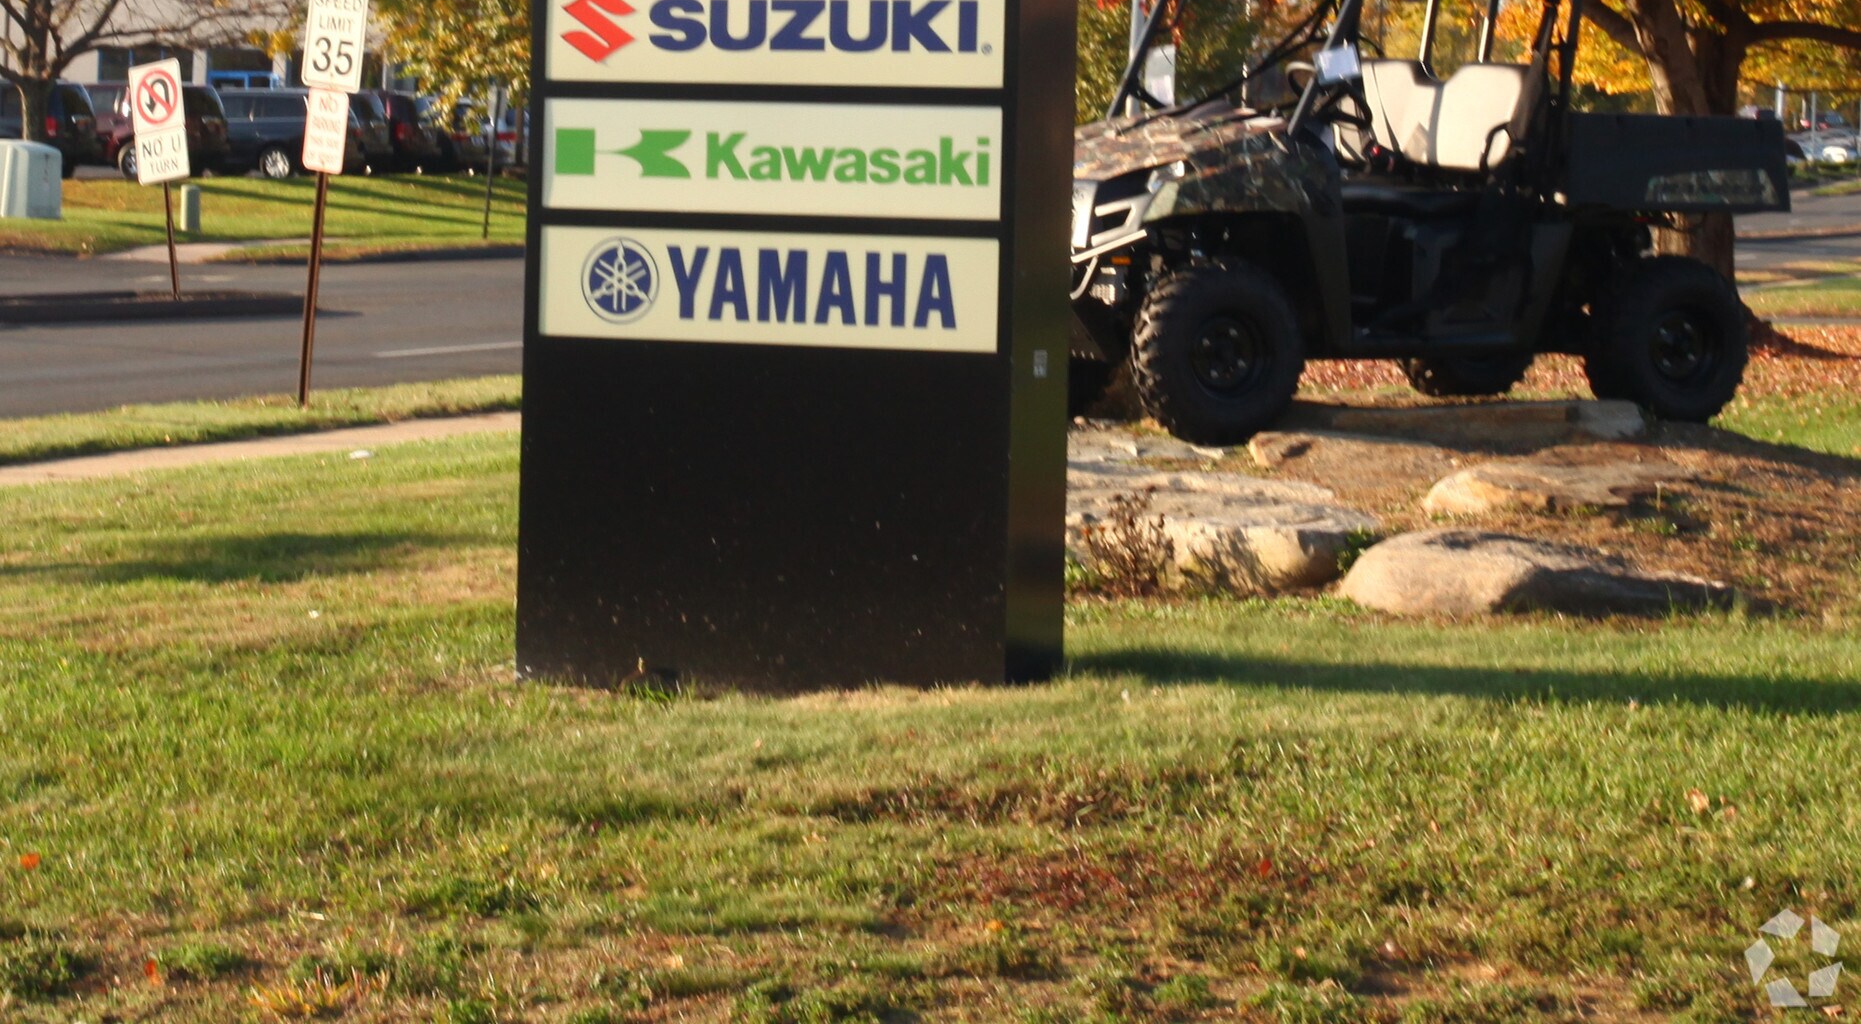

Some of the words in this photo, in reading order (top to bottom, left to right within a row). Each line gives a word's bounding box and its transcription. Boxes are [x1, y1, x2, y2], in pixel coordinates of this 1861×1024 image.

[318, 15, 355, 34] LIMIT
[312, 36, 354, 76] 35
[141, 137, 163, 160] NO
[171, 133, 182, 154] U
[706, 131, 991, 187] Kawasaki
[149, 156, 180, 176] TURN
[666, 245, 957, 331] YAMAHA
